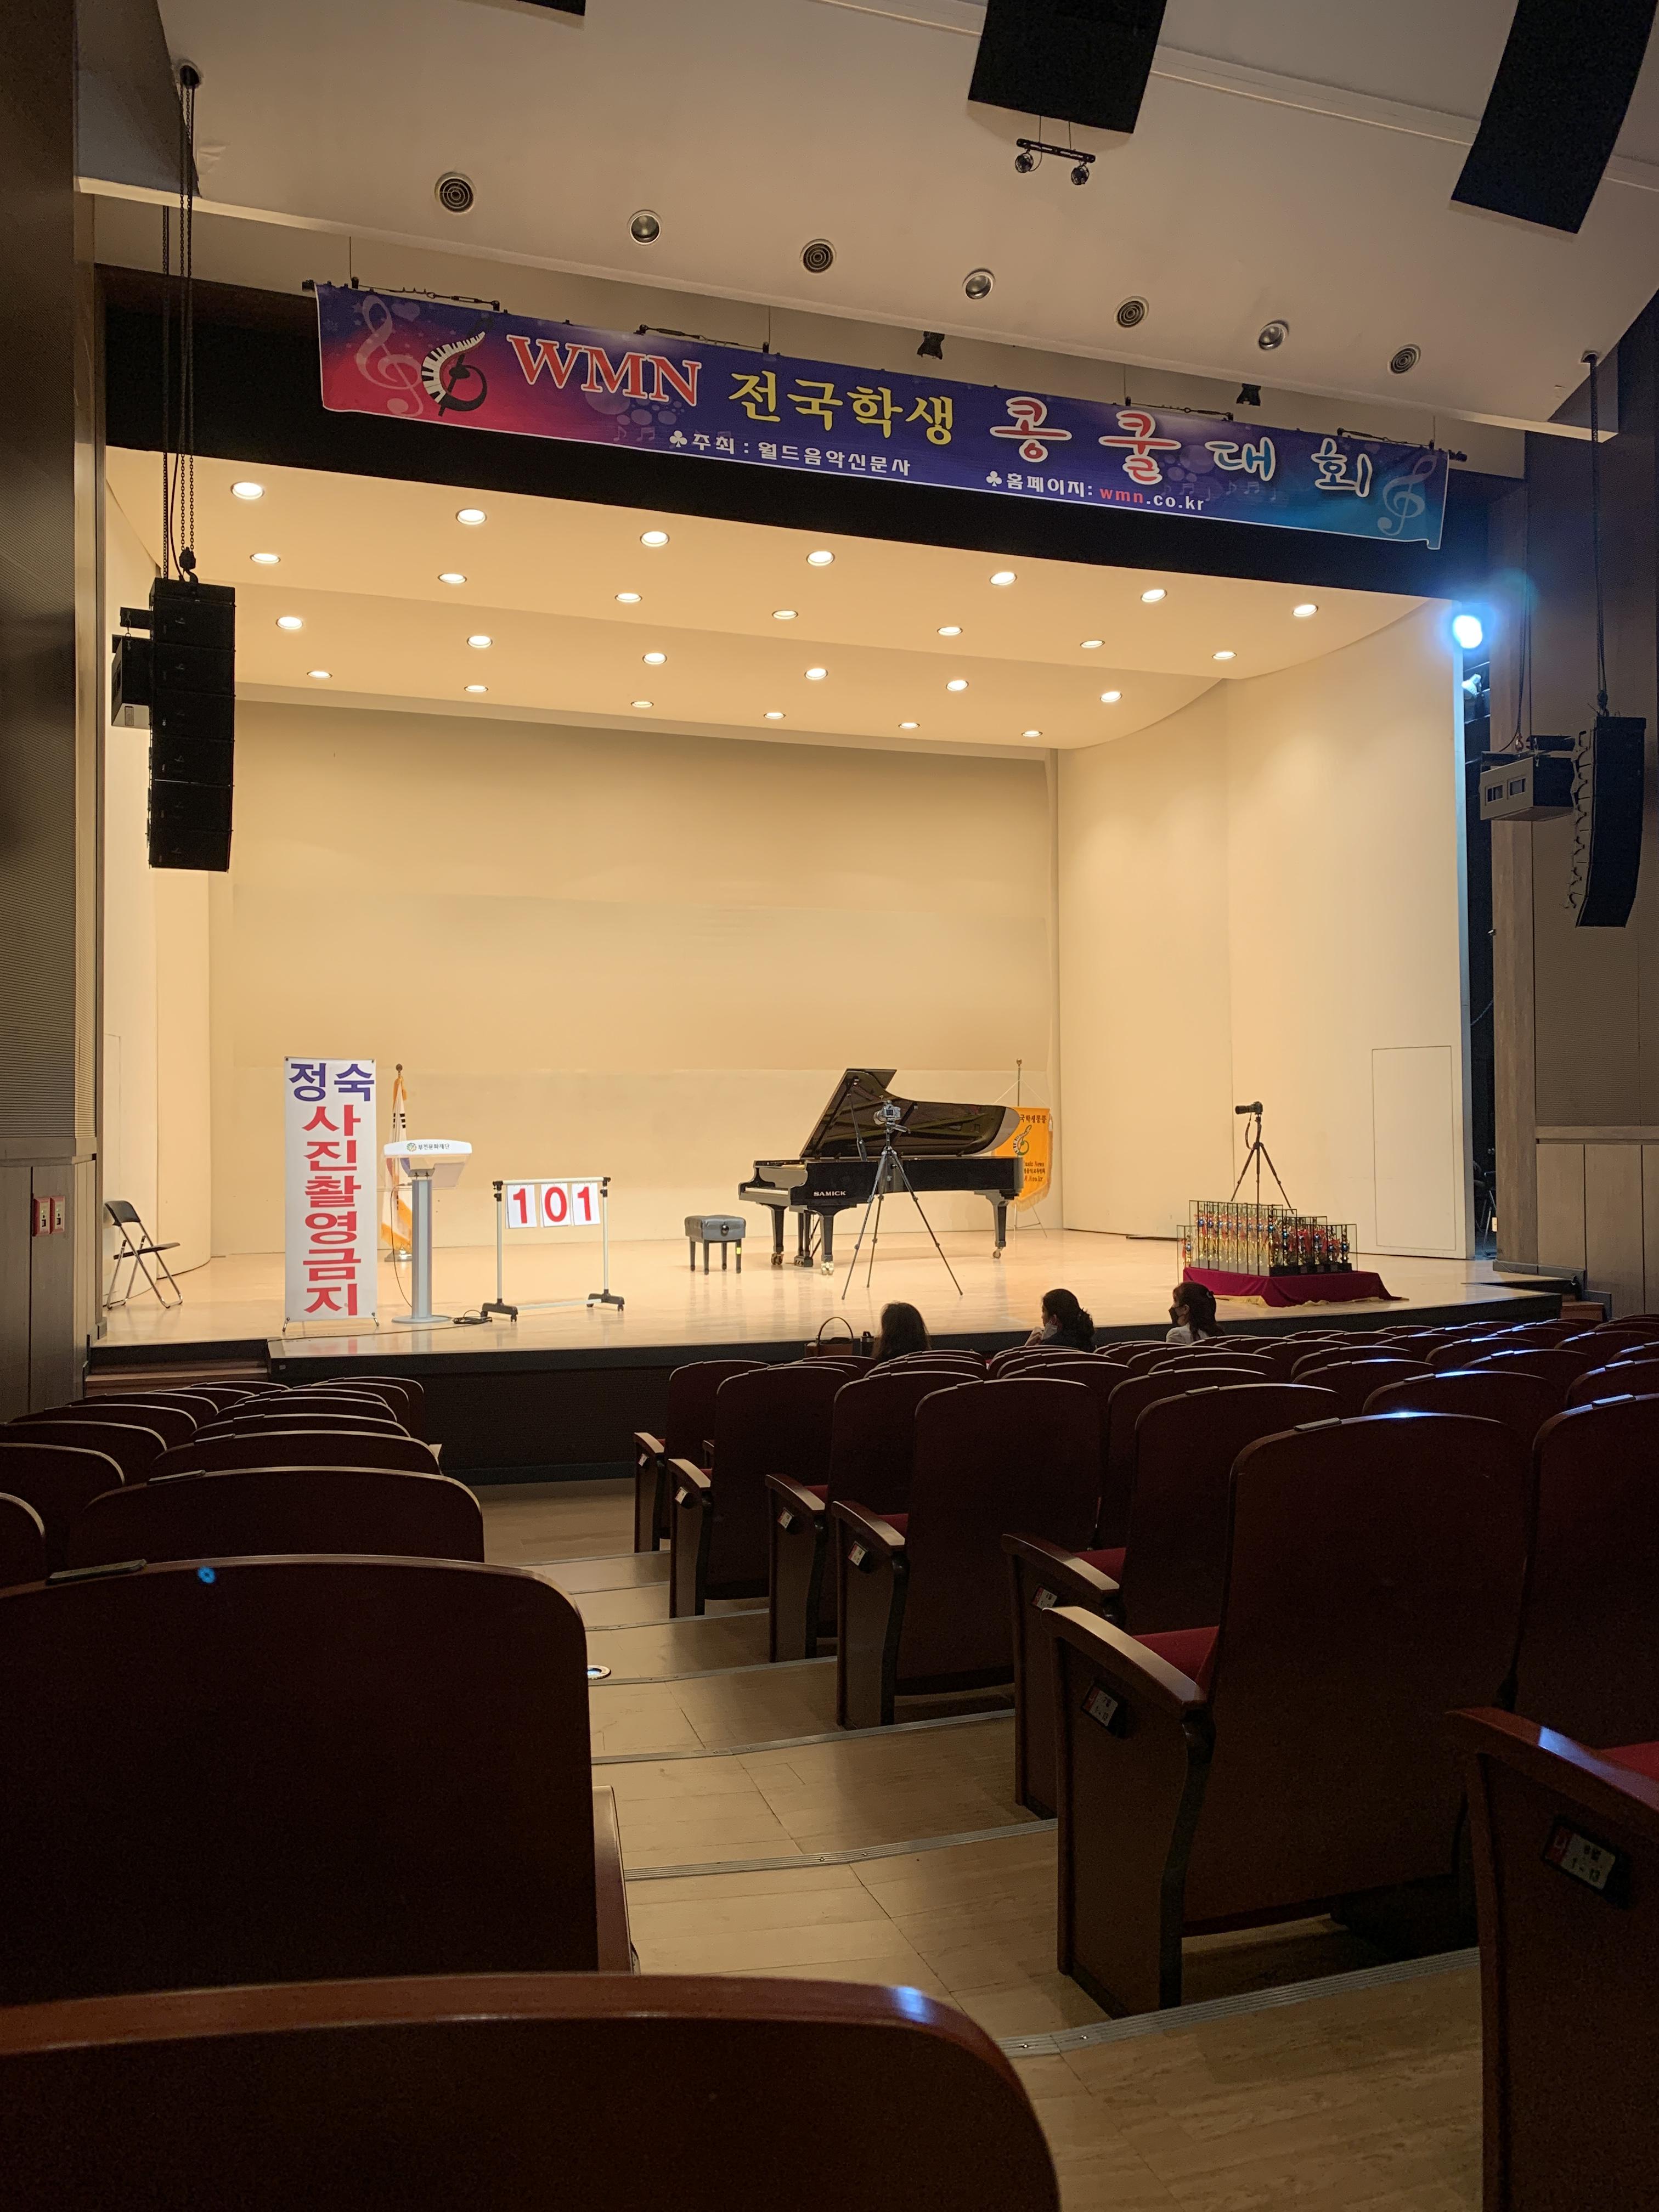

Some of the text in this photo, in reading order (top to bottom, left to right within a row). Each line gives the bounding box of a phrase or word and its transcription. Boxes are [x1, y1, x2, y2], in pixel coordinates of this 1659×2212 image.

[506, 335, 702, 406] WMN
[729, 370, 953, 445] 전국학생
[758, 442, 911, 476] 월드음악신문사
[1099, 487, 1205, 511] wmn.co.kr
[289, 1062, 375, 1102] 정숙
[512, 1186, 592, 1224] 101
